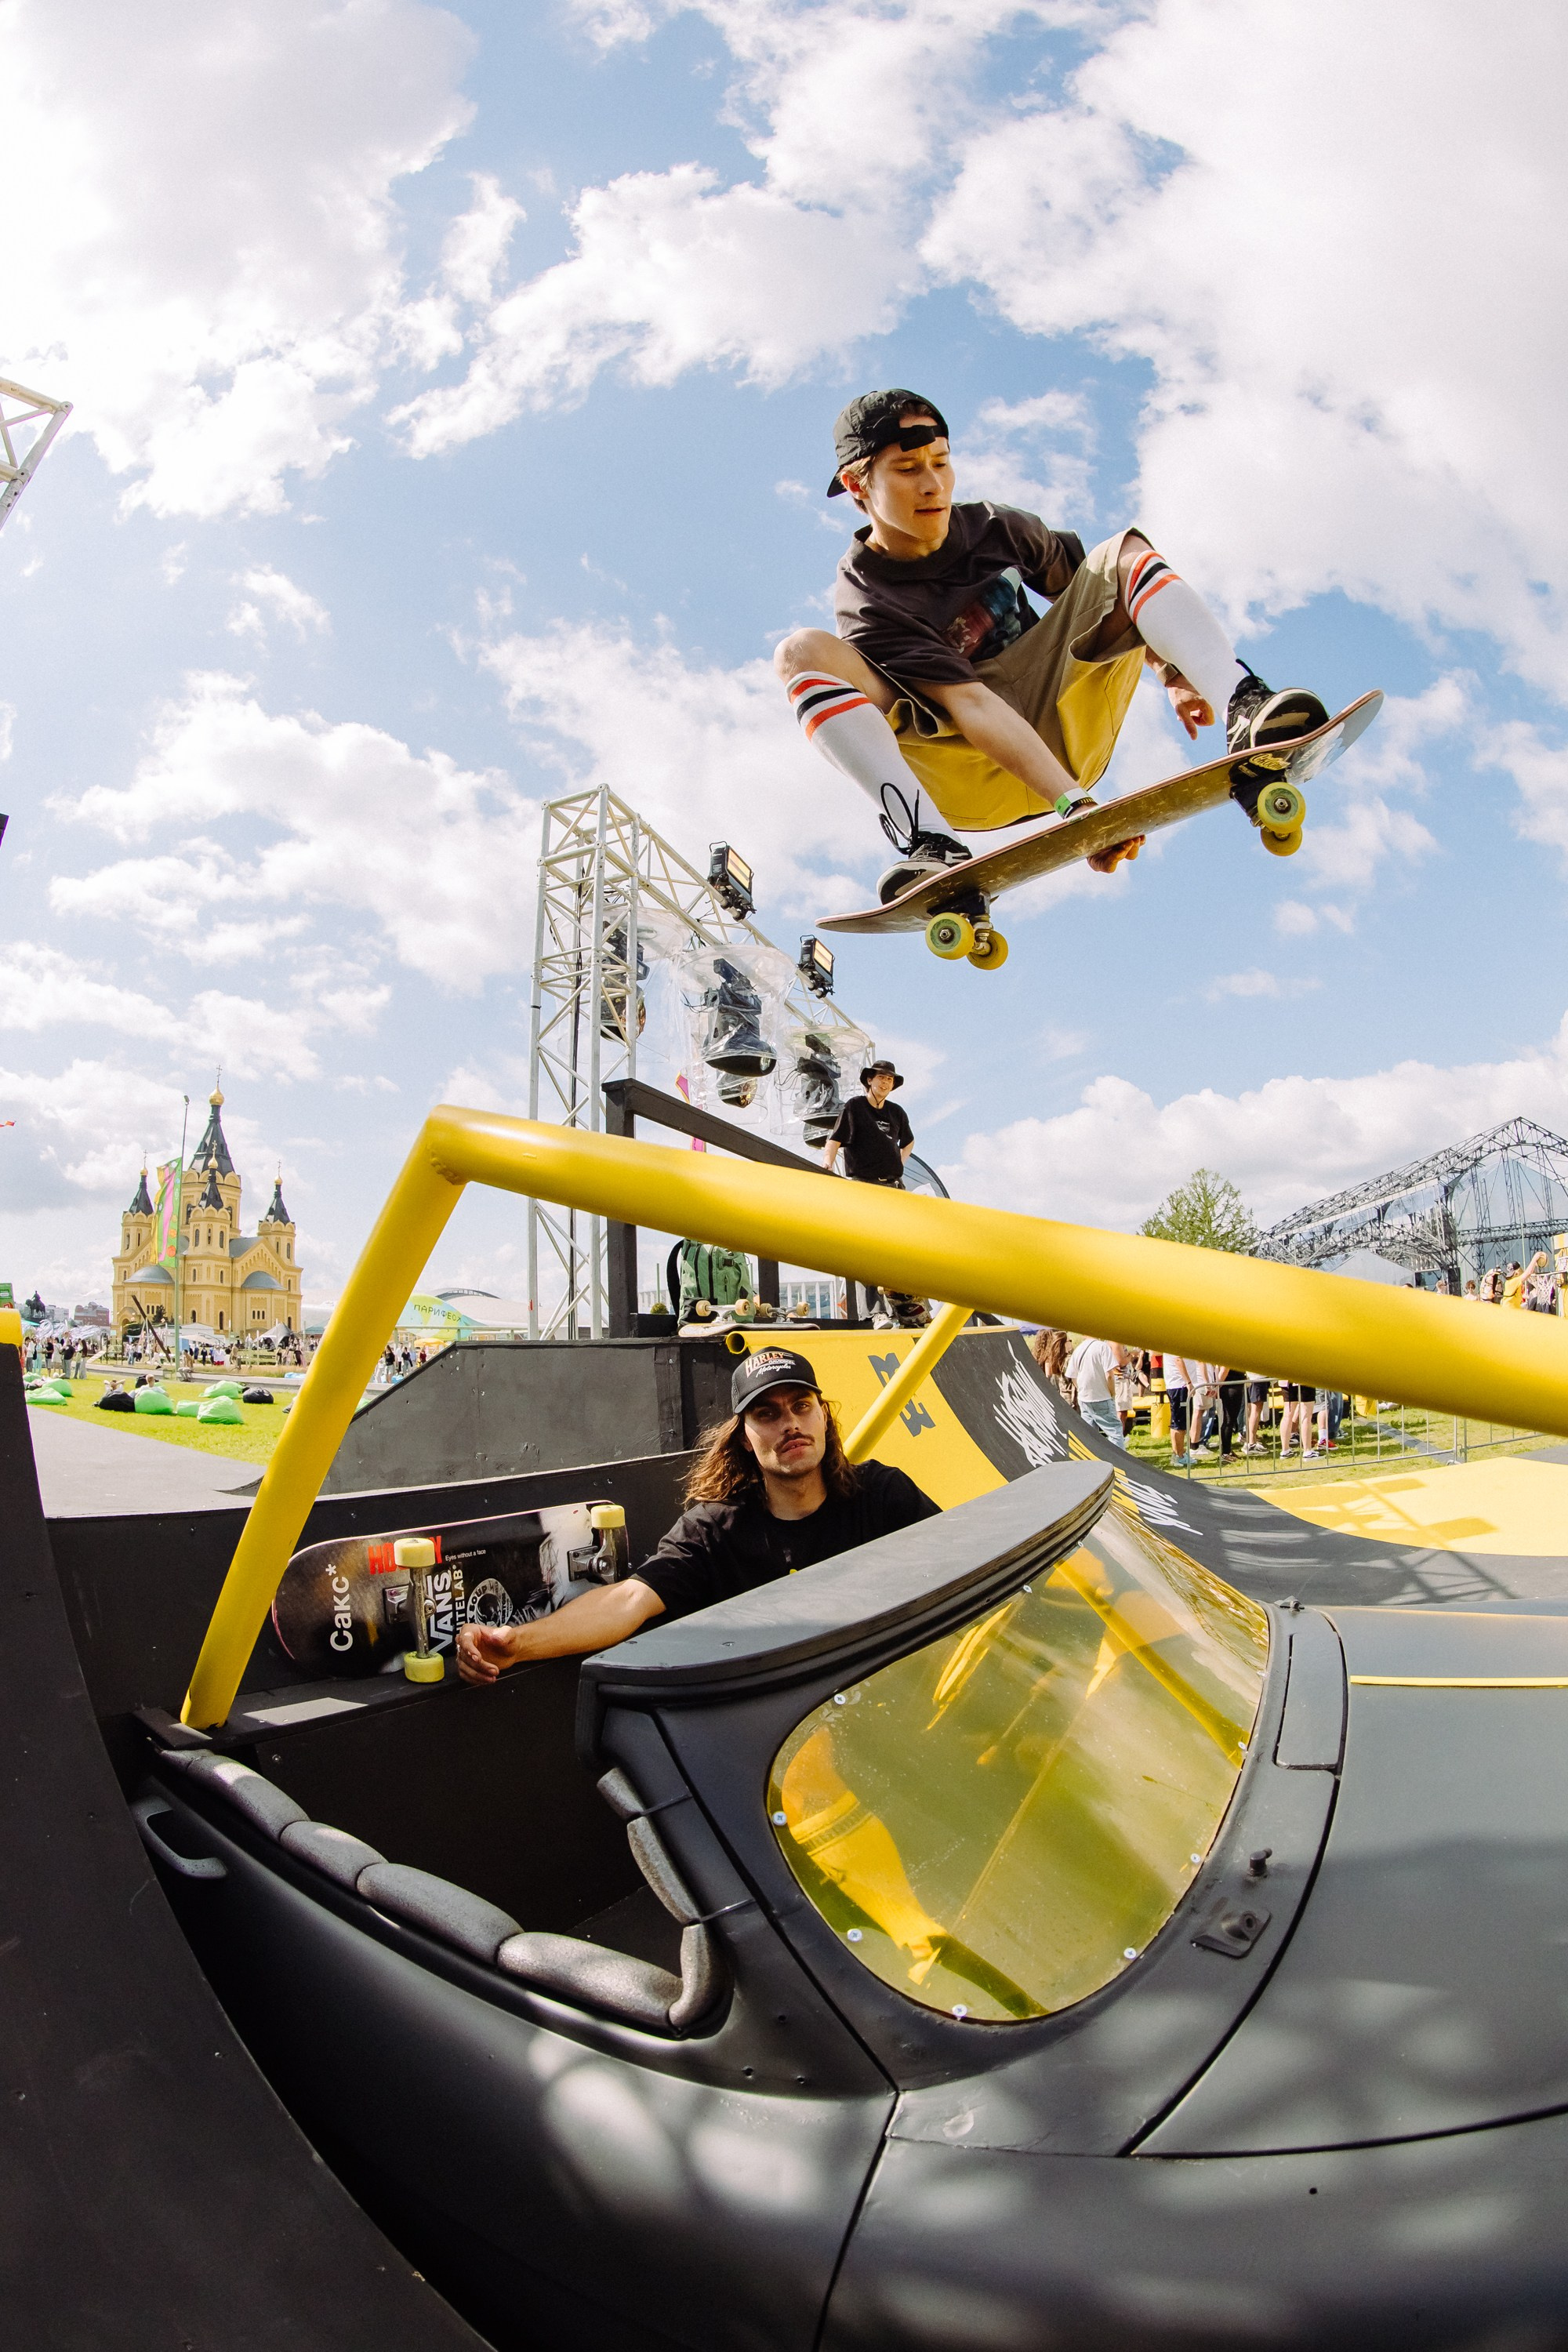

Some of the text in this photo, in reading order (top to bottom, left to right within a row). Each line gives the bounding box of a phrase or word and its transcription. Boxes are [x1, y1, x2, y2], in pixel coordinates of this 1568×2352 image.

[745, 1352, 785, 1378] HARLEY
[756, 1363, 791, 1377] Motorcycles
[368, 1535, 442, 1575] HOY
[426, 1570, 454, 1653] VANS
